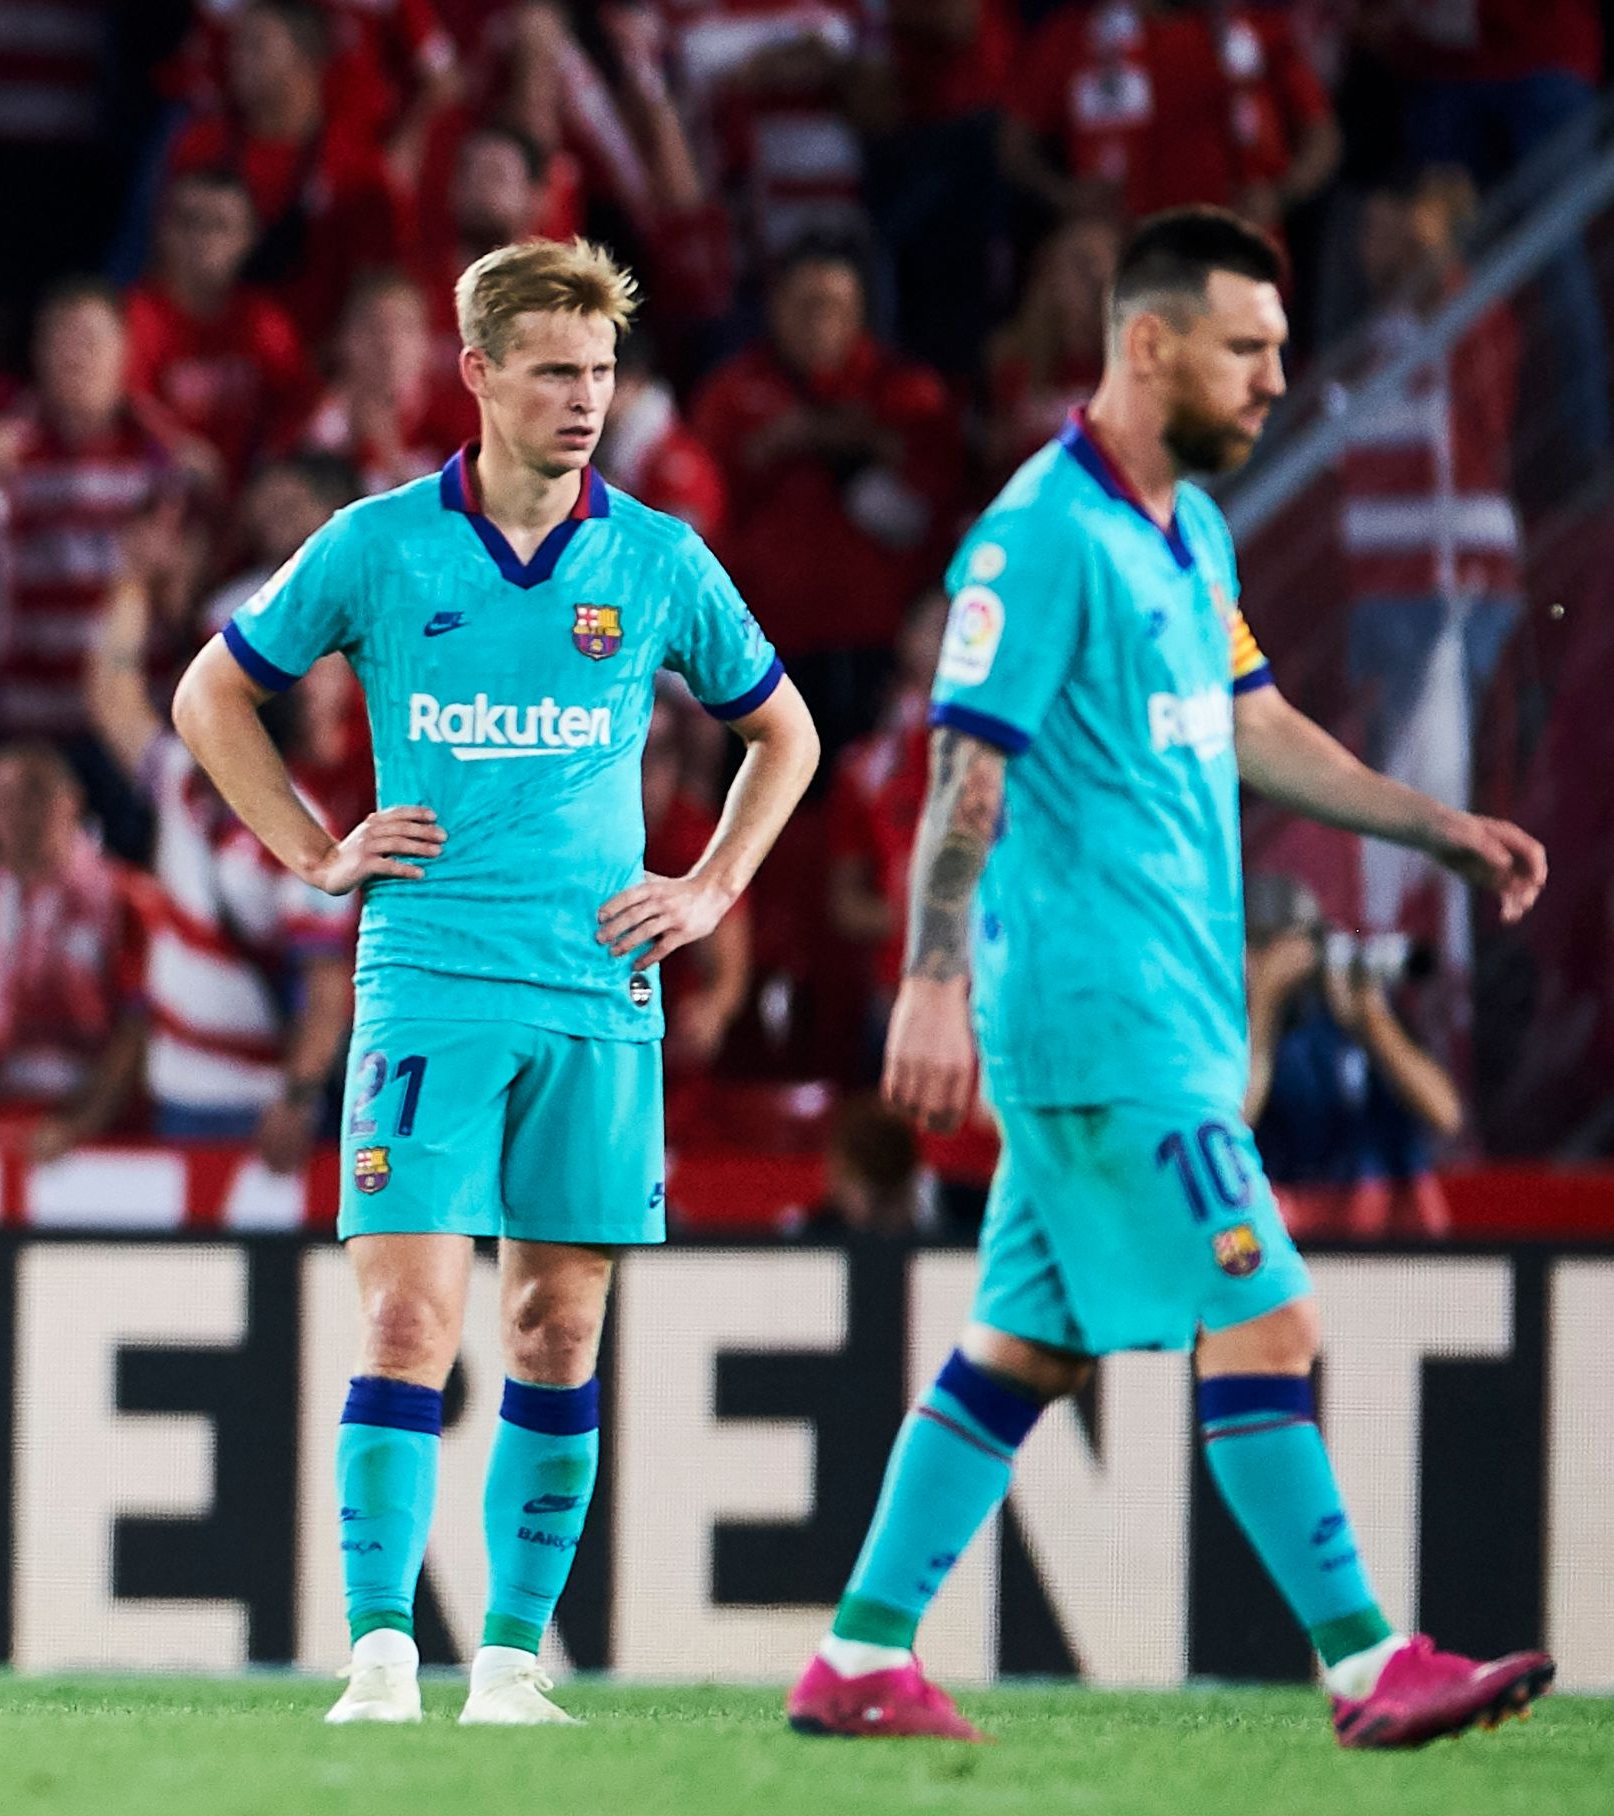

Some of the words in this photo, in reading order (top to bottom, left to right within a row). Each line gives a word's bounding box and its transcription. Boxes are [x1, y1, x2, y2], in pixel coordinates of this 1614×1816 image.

[408, 692, 612, 749] Rakuten
[347, 1051, 428, 1138] 21
[1156, 1119, 1255, 1225] 10
